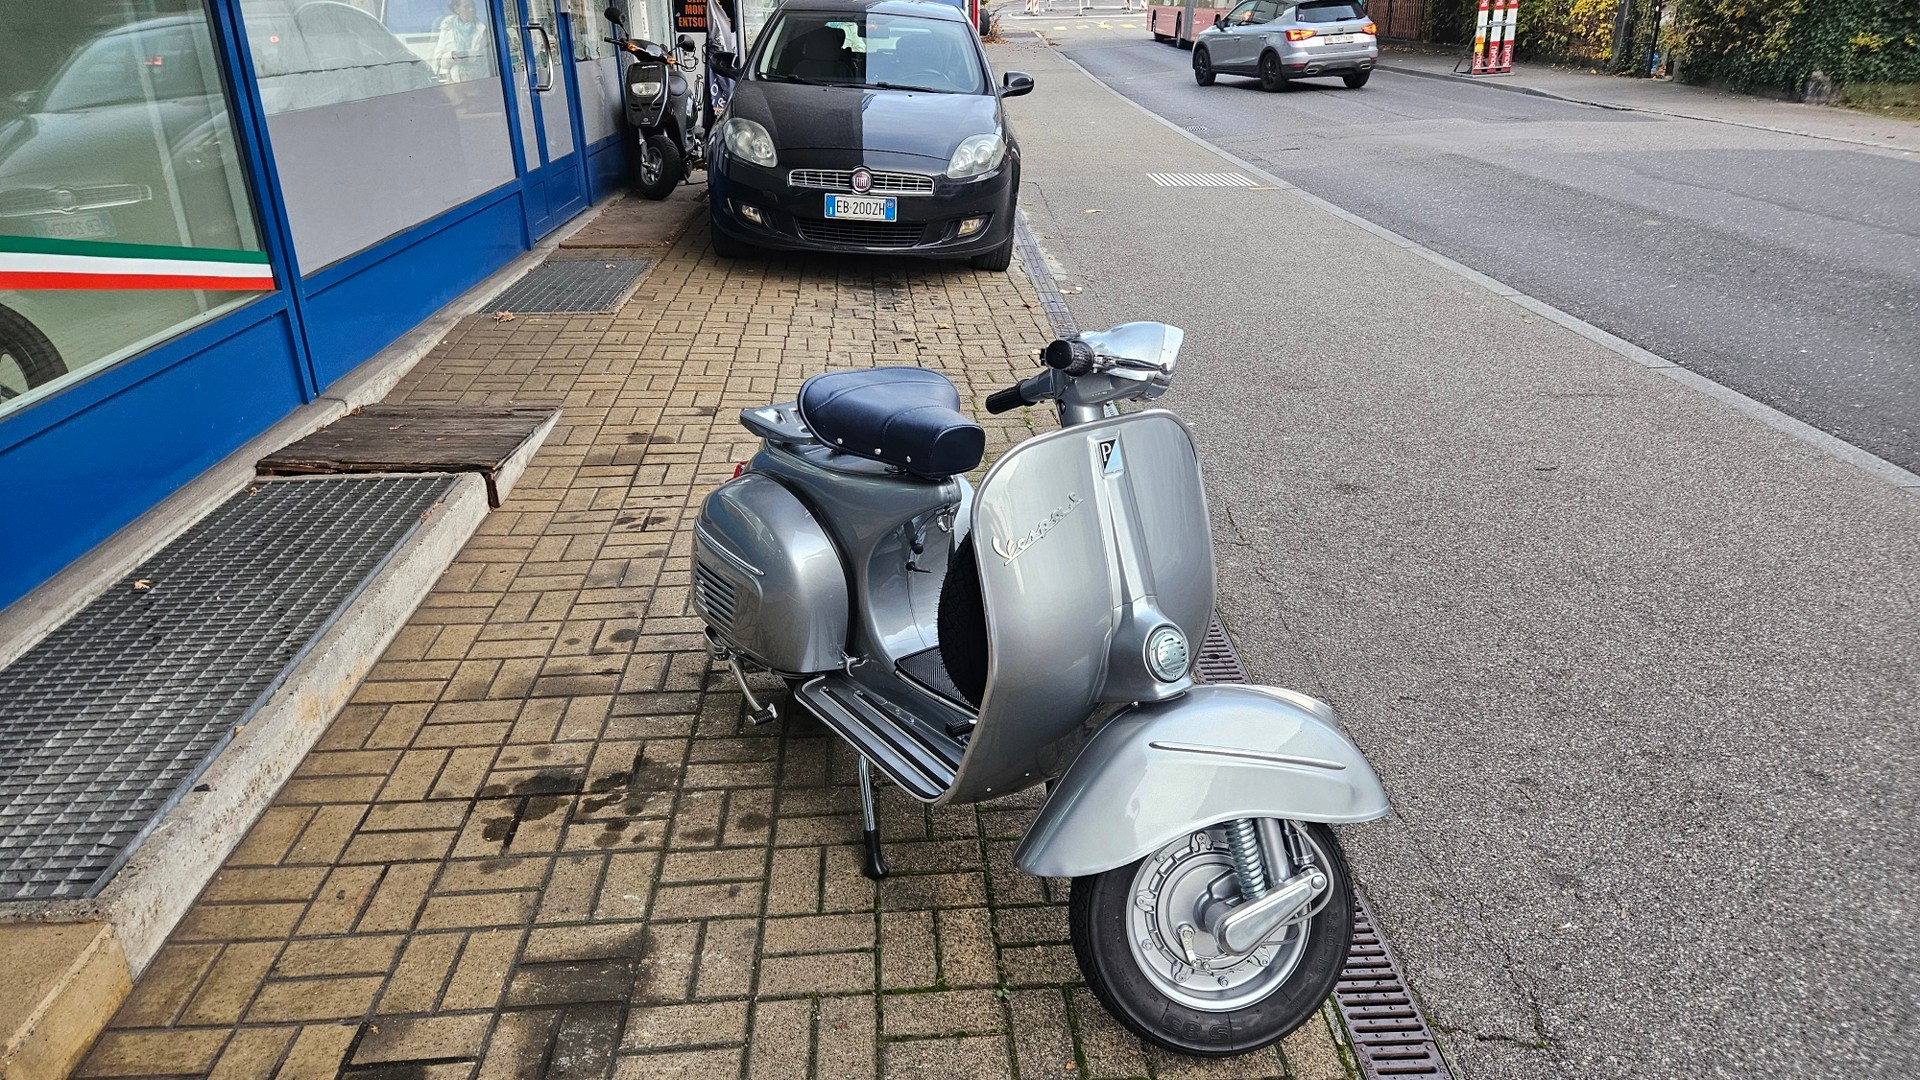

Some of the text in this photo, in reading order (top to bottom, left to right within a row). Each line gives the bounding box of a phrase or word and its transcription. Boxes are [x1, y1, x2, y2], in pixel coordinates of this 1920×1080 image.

[856, 177, 867, 187] FIAT
[836, 200, 850, 213] EB
[852, 201, 885, 216] 200ZH
[1101, 442, 1112, 463] P
[991, 506, 1066, 567] Vespa
